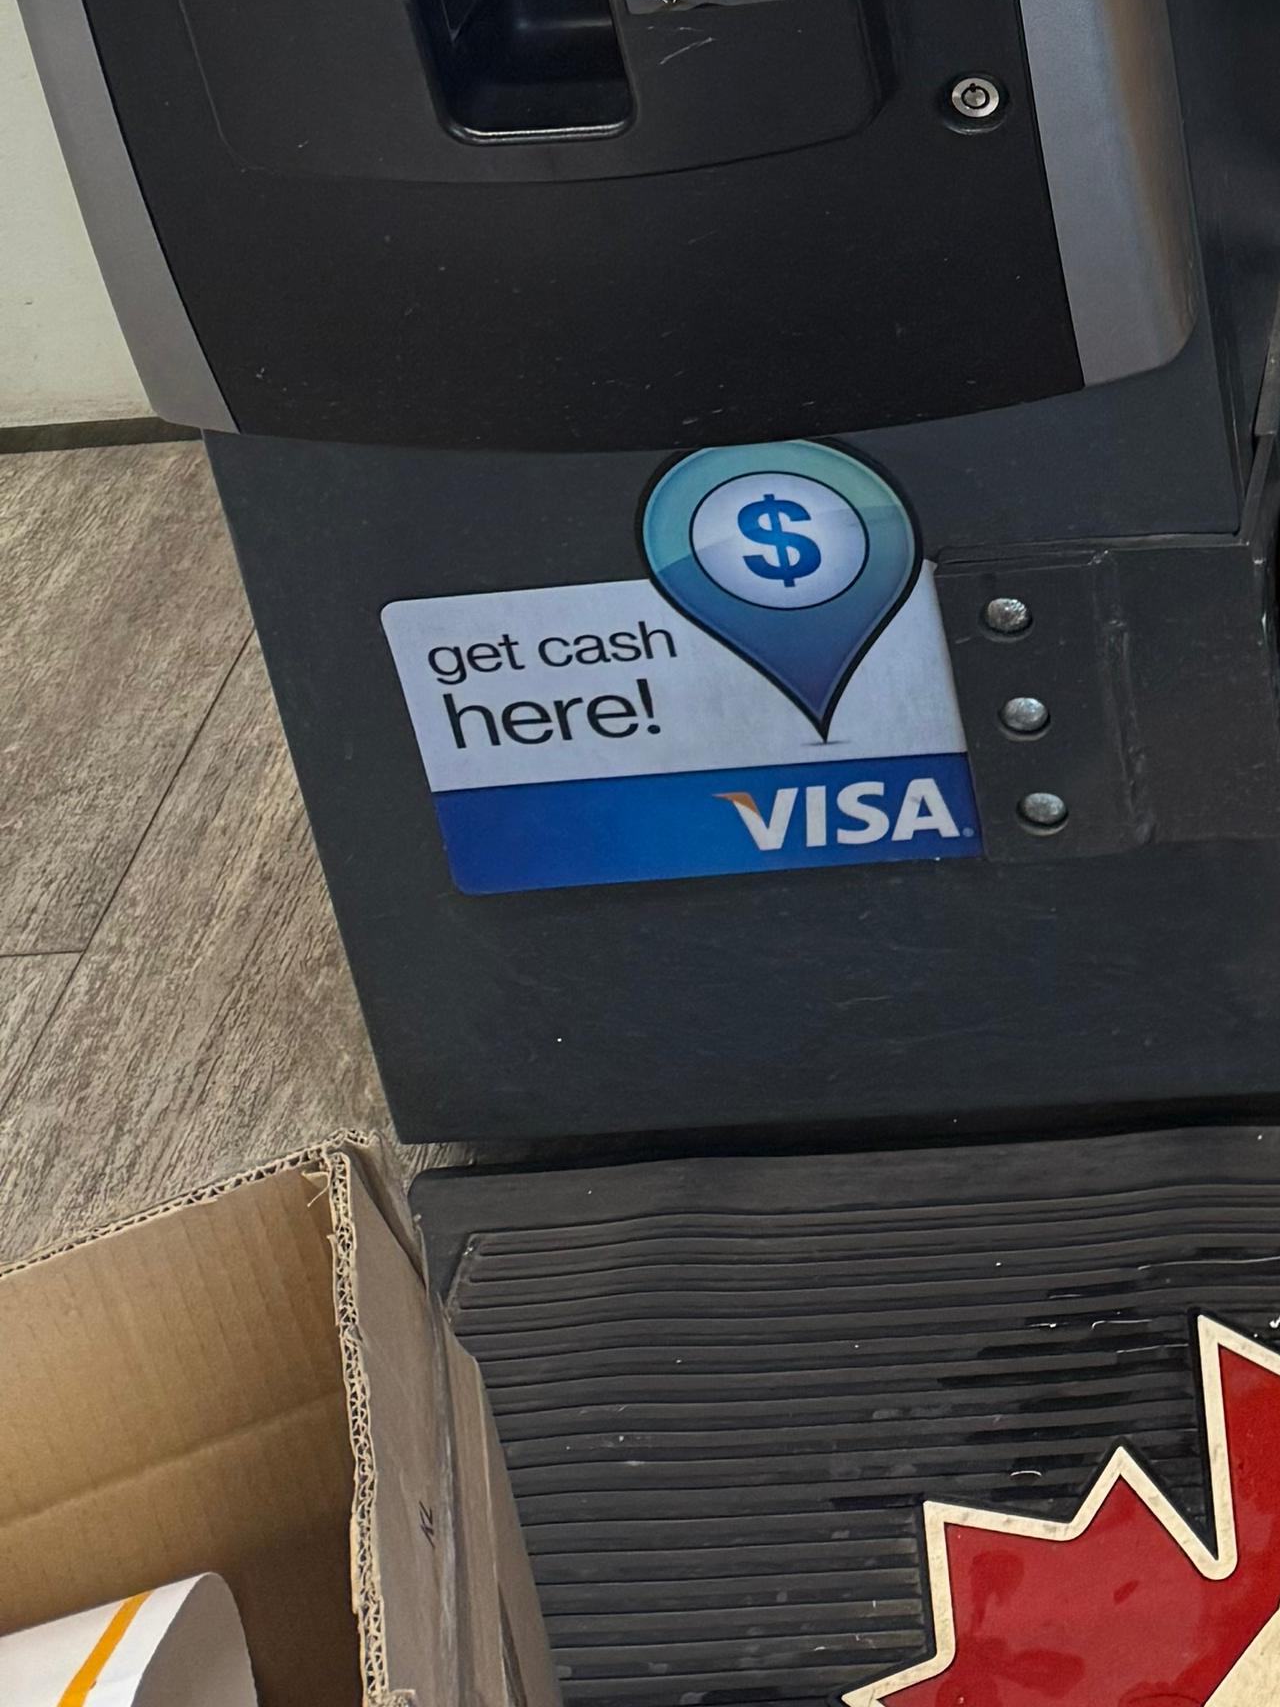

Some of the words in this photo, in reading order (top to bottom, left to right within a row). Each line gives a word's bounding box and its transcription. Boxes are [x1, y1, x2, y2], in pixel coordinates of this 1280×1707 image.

[425, 632, 527, 685] get
[537, 621, 678, 669] cash
[447, 679, 663, 750] here!
[714, 779, 960, 853] VISA
